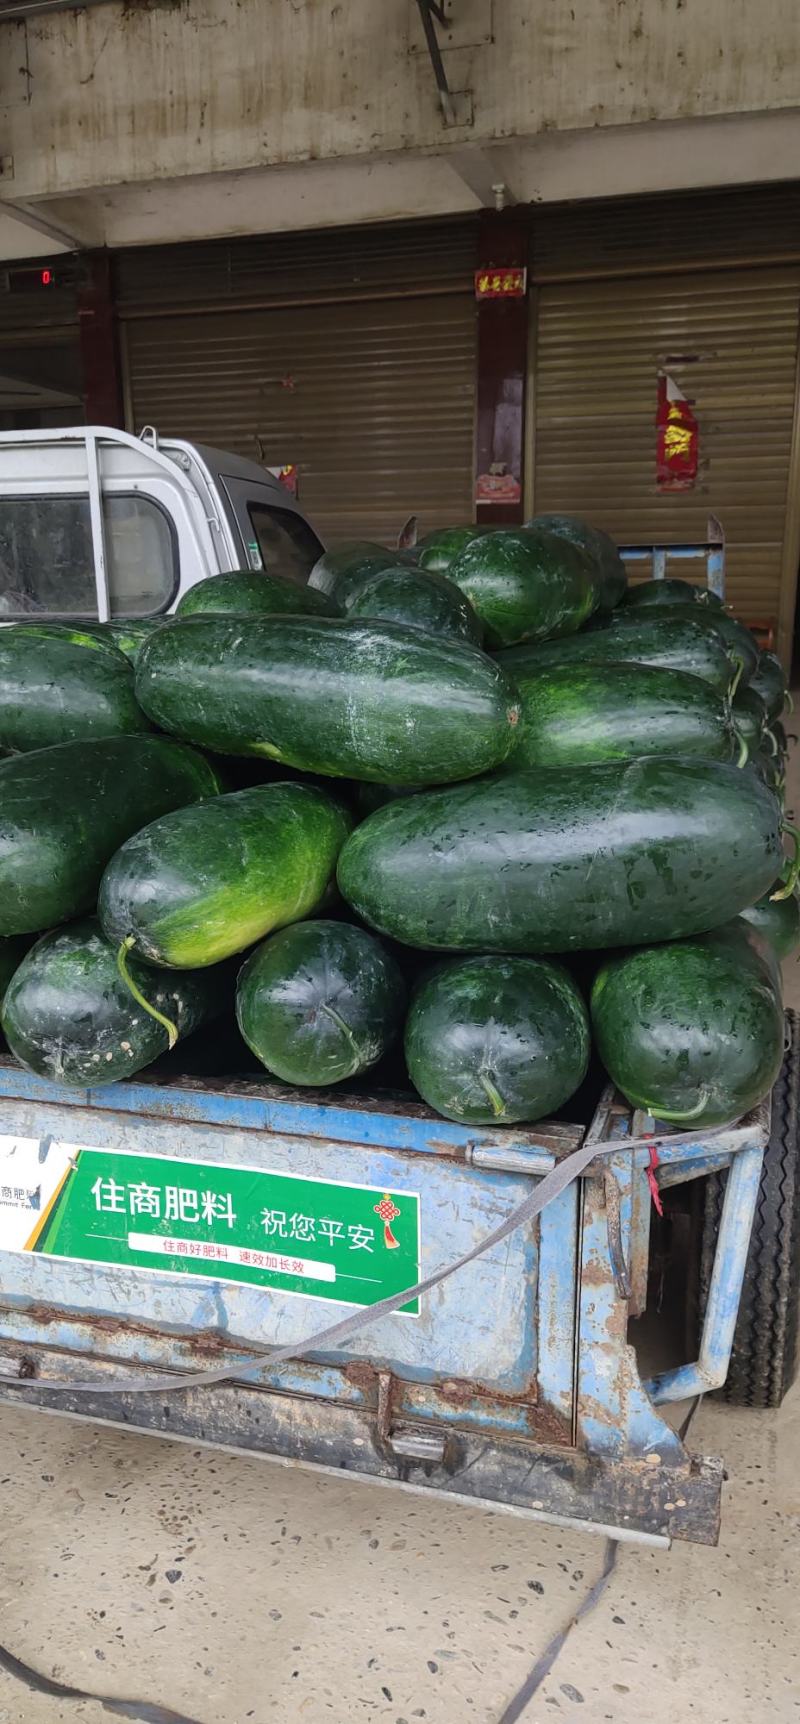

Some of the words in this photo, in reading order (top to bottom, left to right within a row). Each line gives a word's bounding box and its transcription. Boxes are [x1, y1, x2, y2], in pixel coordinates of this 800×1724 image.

[90, 1176, 238, 1229] 住商肥料
[260, 1207, 375, 1254] 祝您平安
[162, 1239, 229, 1261] 住商好肥料
[239, 1250, 305, 1274] 速效加长效
